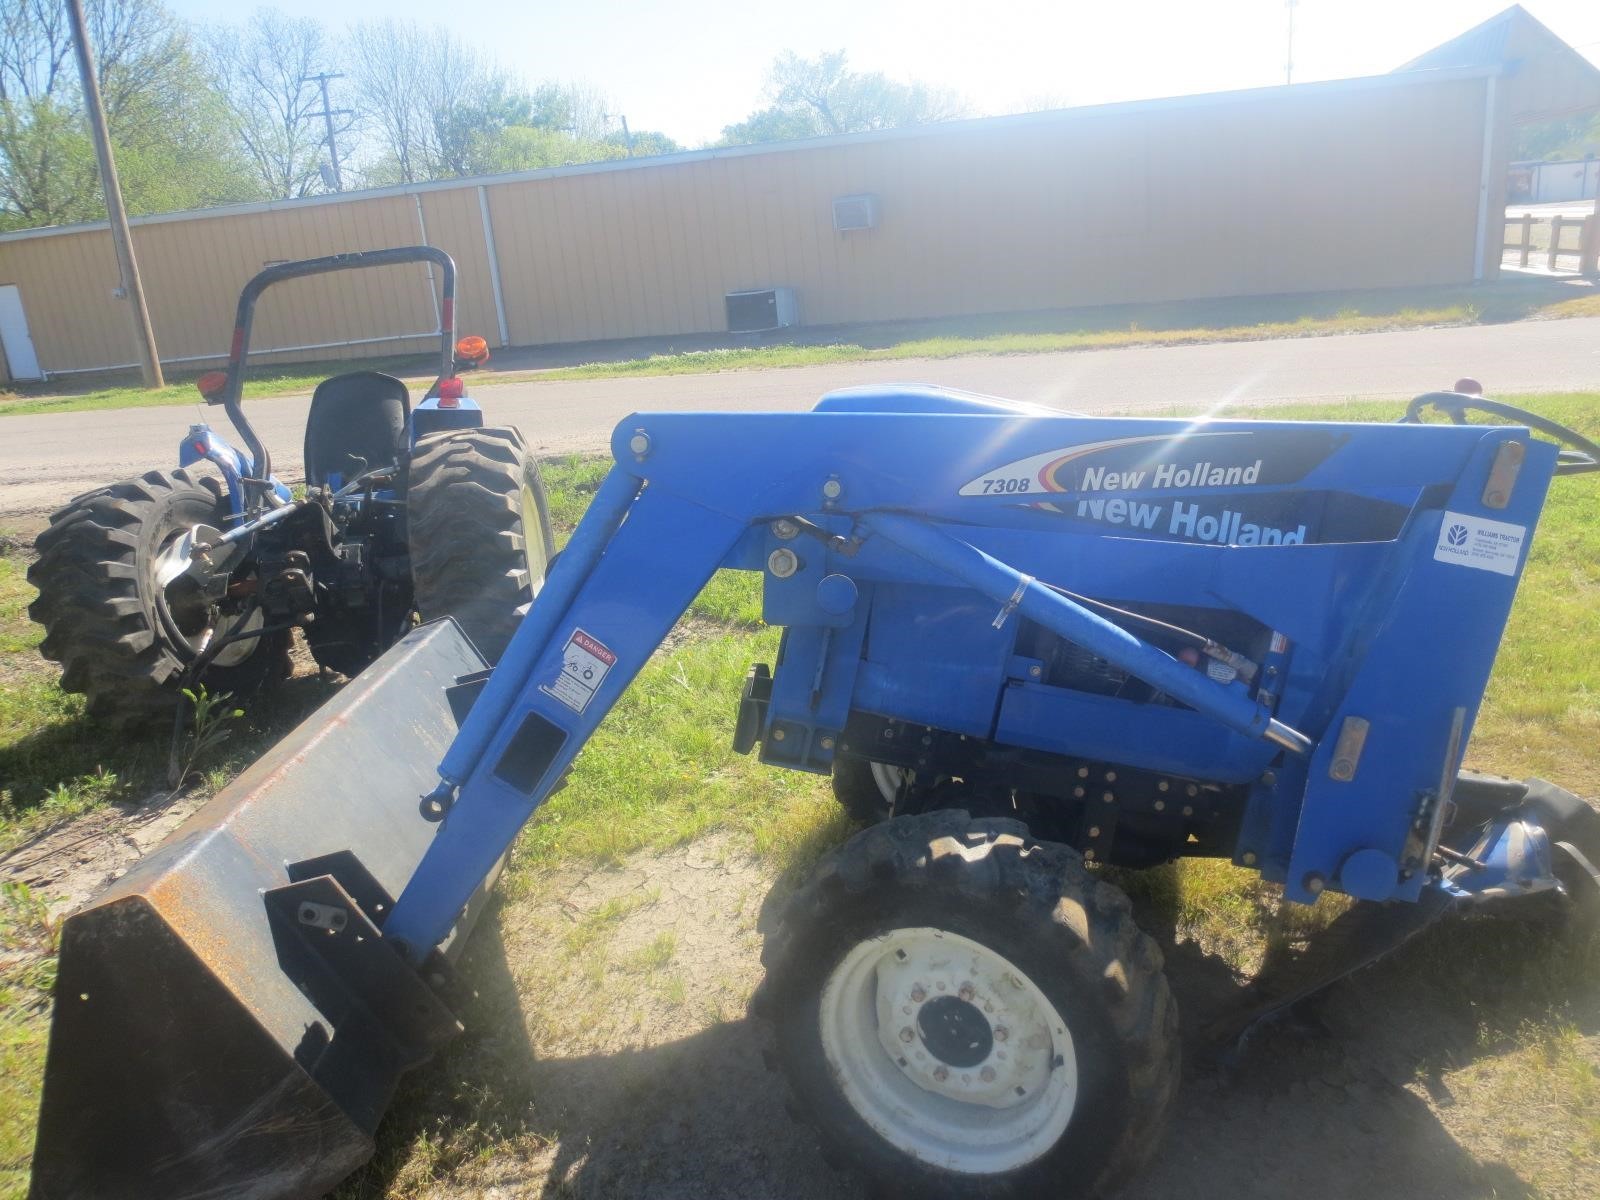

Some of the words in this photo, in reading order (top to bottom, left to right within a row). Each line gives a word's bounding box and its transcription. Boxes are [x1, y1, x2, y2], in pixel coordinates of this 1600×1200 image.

[982, 478, 1030, 493] 7308
[1081, 467, 1146, 492] New
[1152, 460, 1262, 488] Holland
[1076, 498, 1162, 529] New
[1169, 501, 1306, 546] Holland
[584, 639, 612, 661] DANGER
